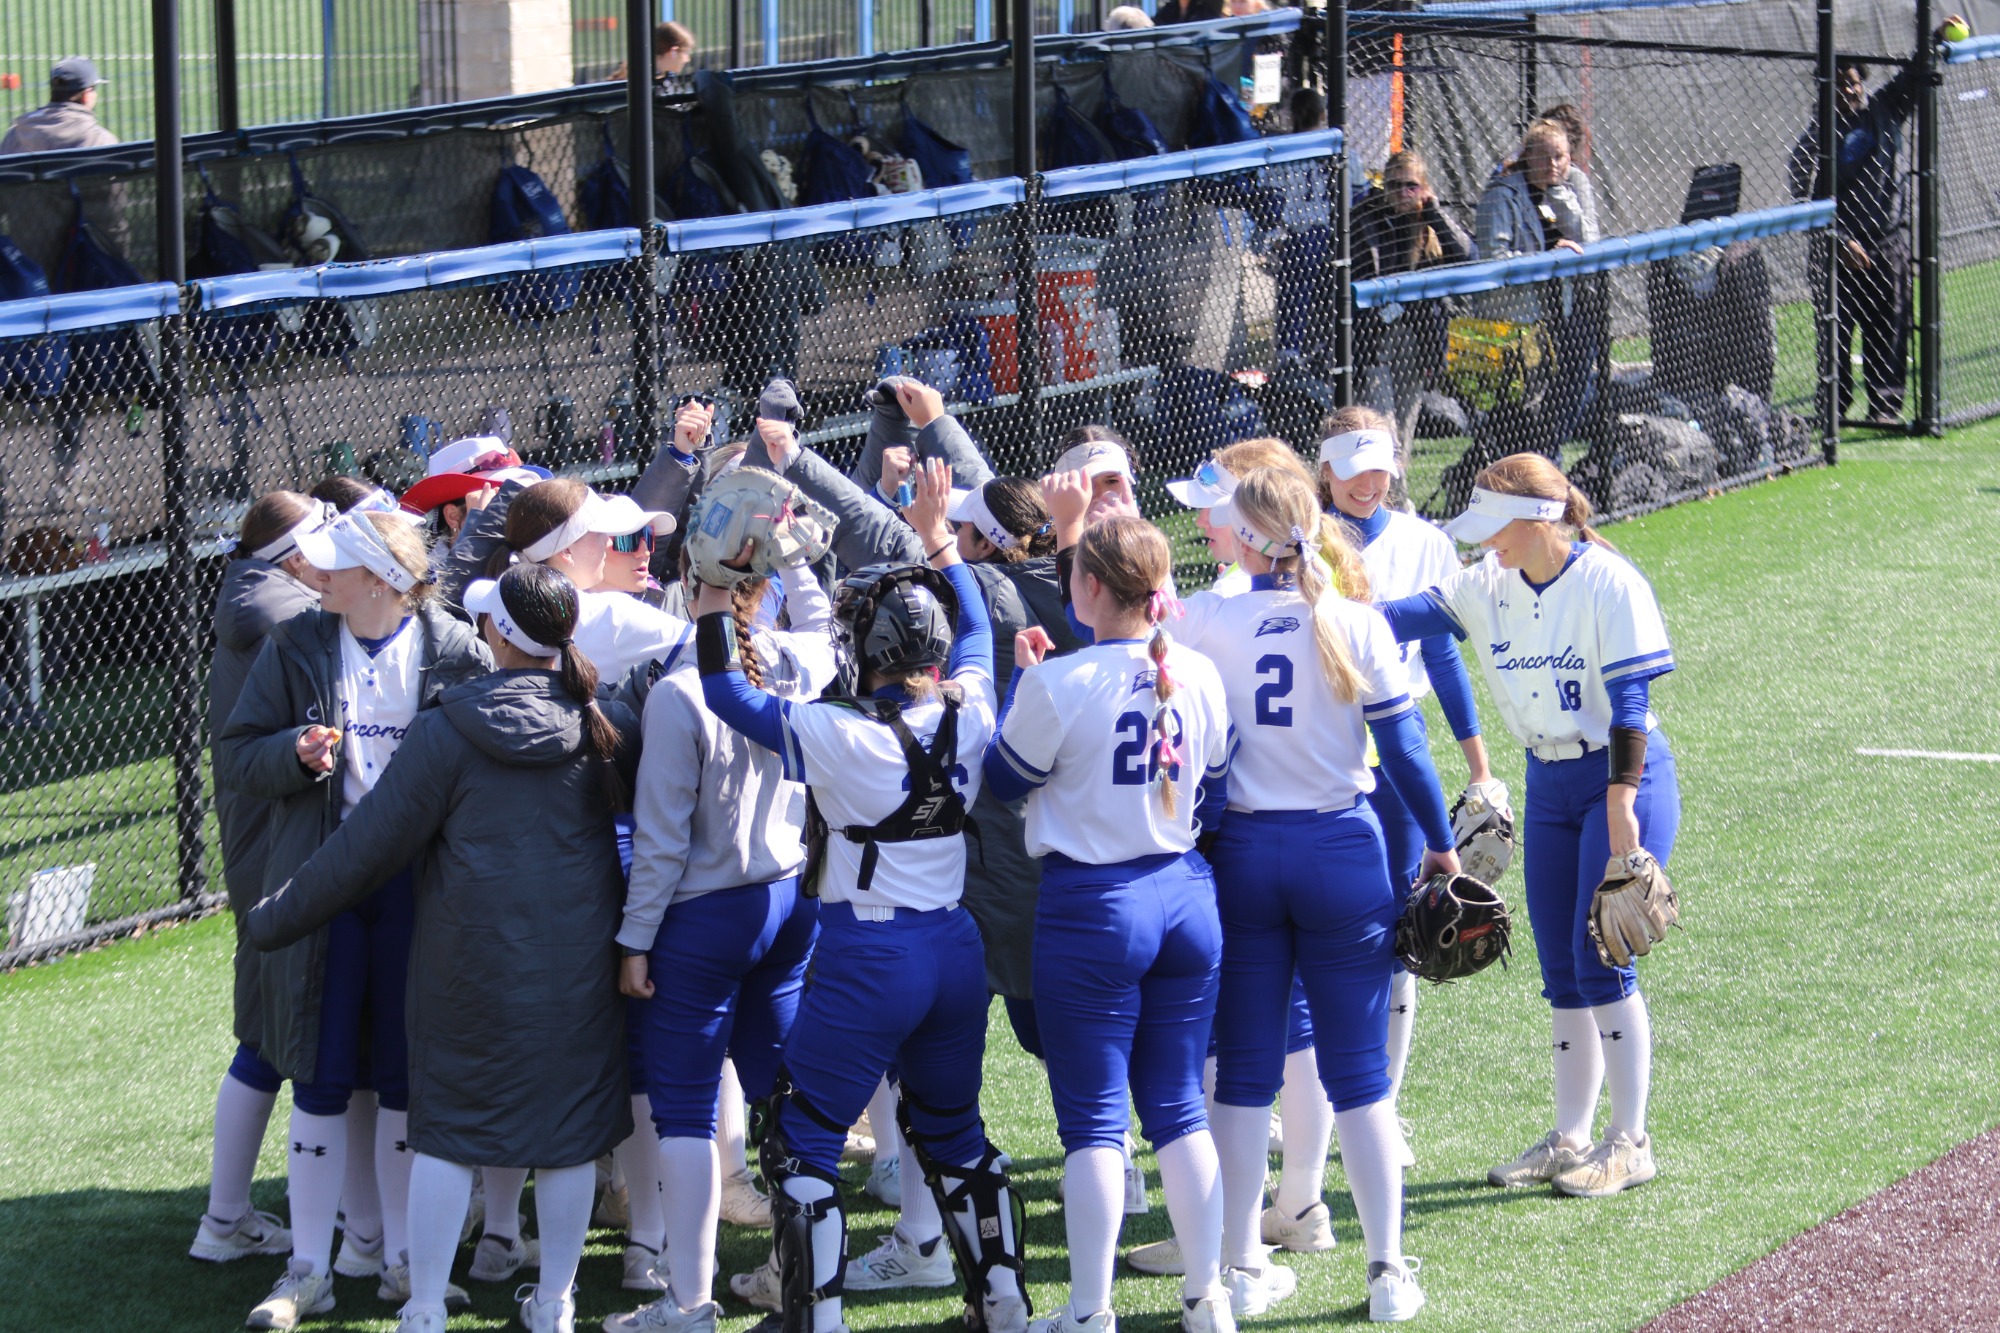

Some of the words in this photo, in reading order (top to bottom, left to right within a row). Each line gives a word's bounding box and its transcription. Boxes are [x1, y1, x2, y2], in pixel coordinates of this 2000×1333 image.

[1490, 640, 1586, 670] Concordia
[1254, 653, 1294, 728] 2
[1555, 679, 1582, 711] 18
